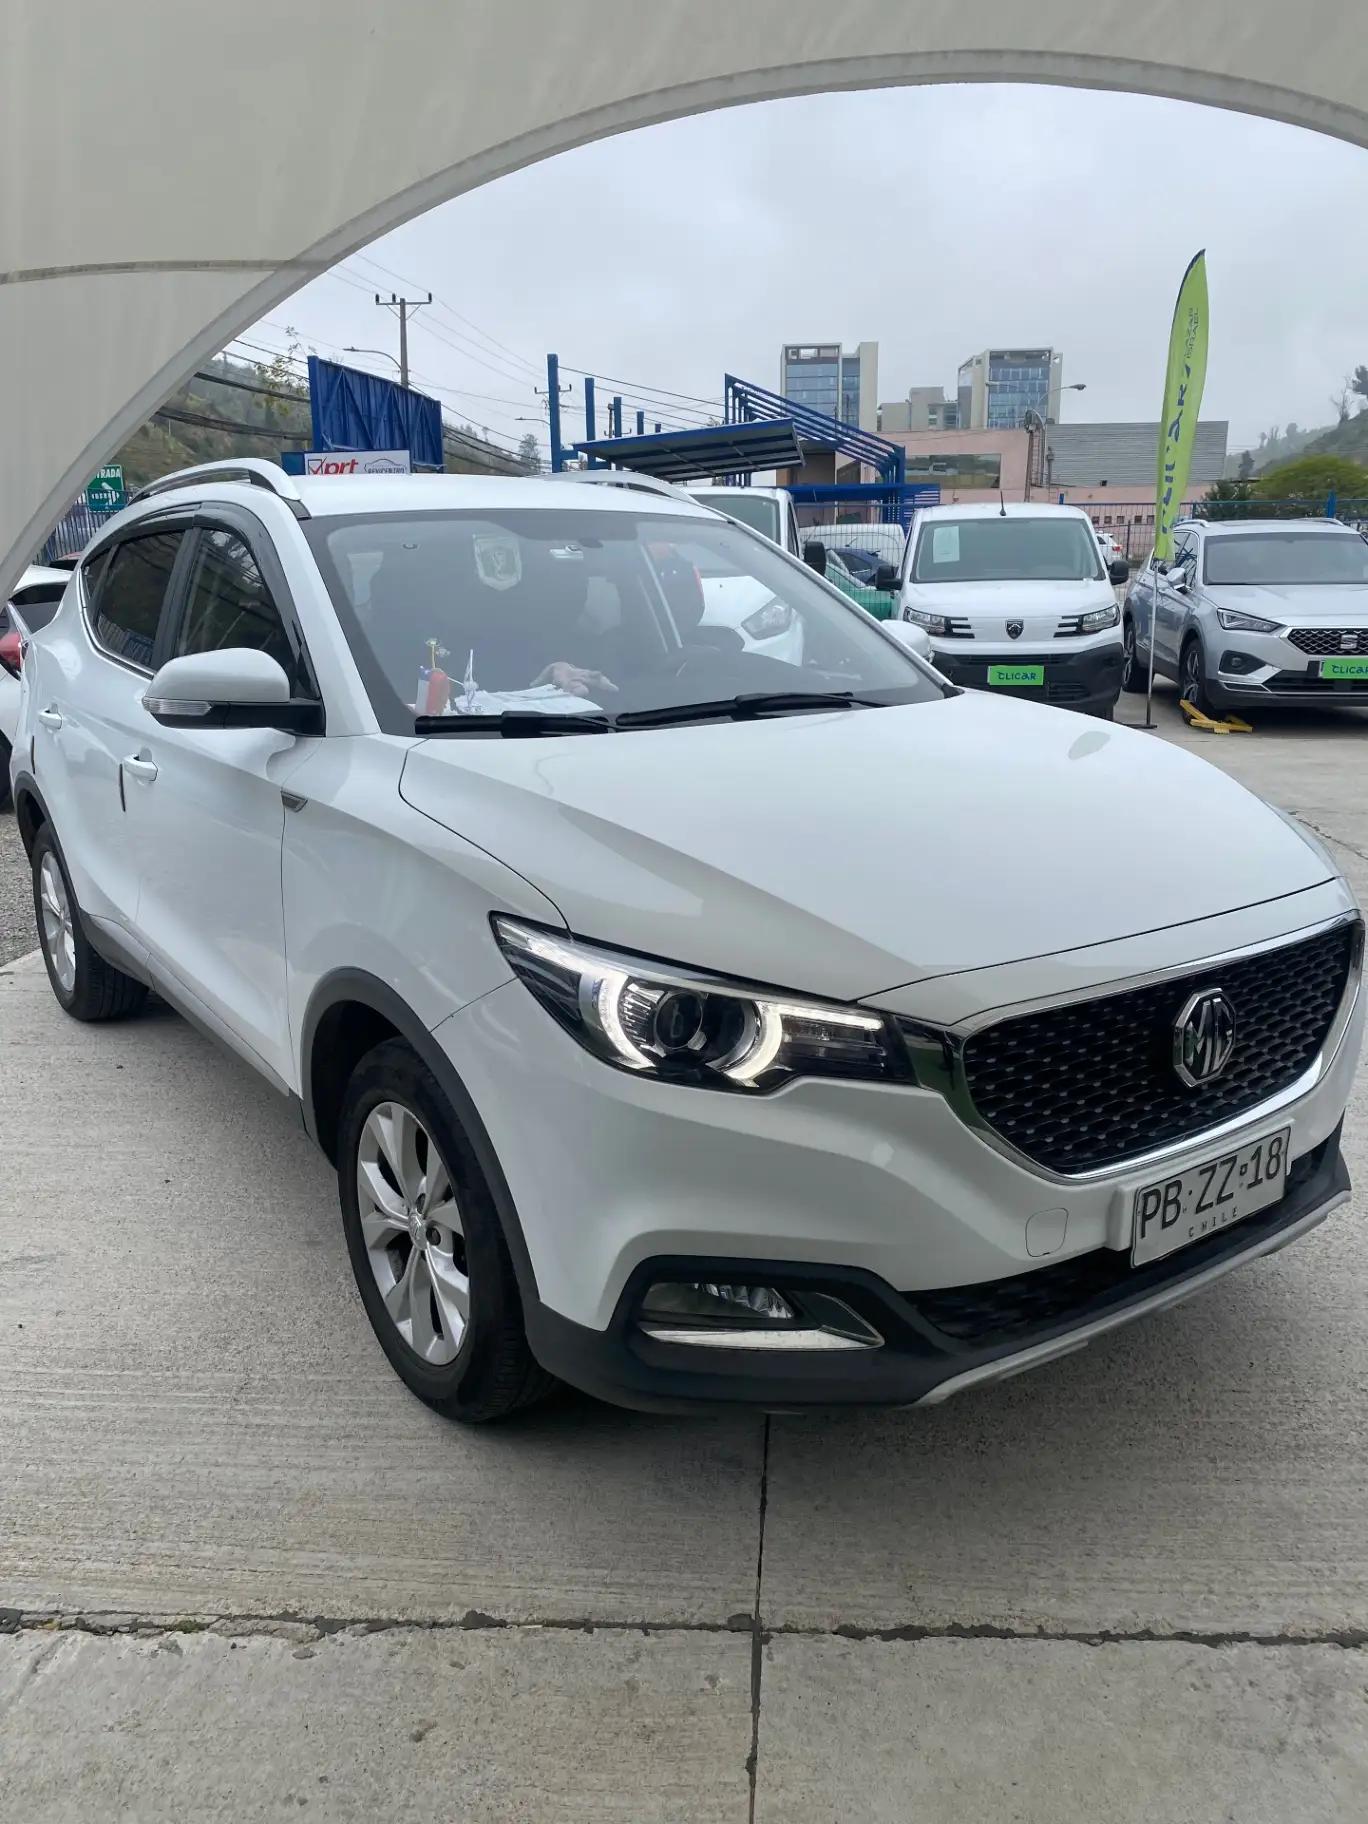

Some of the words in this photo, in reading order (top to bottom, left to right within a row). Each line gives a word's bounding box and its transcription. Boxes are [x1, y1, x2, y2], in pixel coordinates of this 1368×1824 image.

[324, 459, 358, 474] prt
[1185, 998, 1234, 1077] MG
[1187, 1206, 1238, 1238] CHILE
